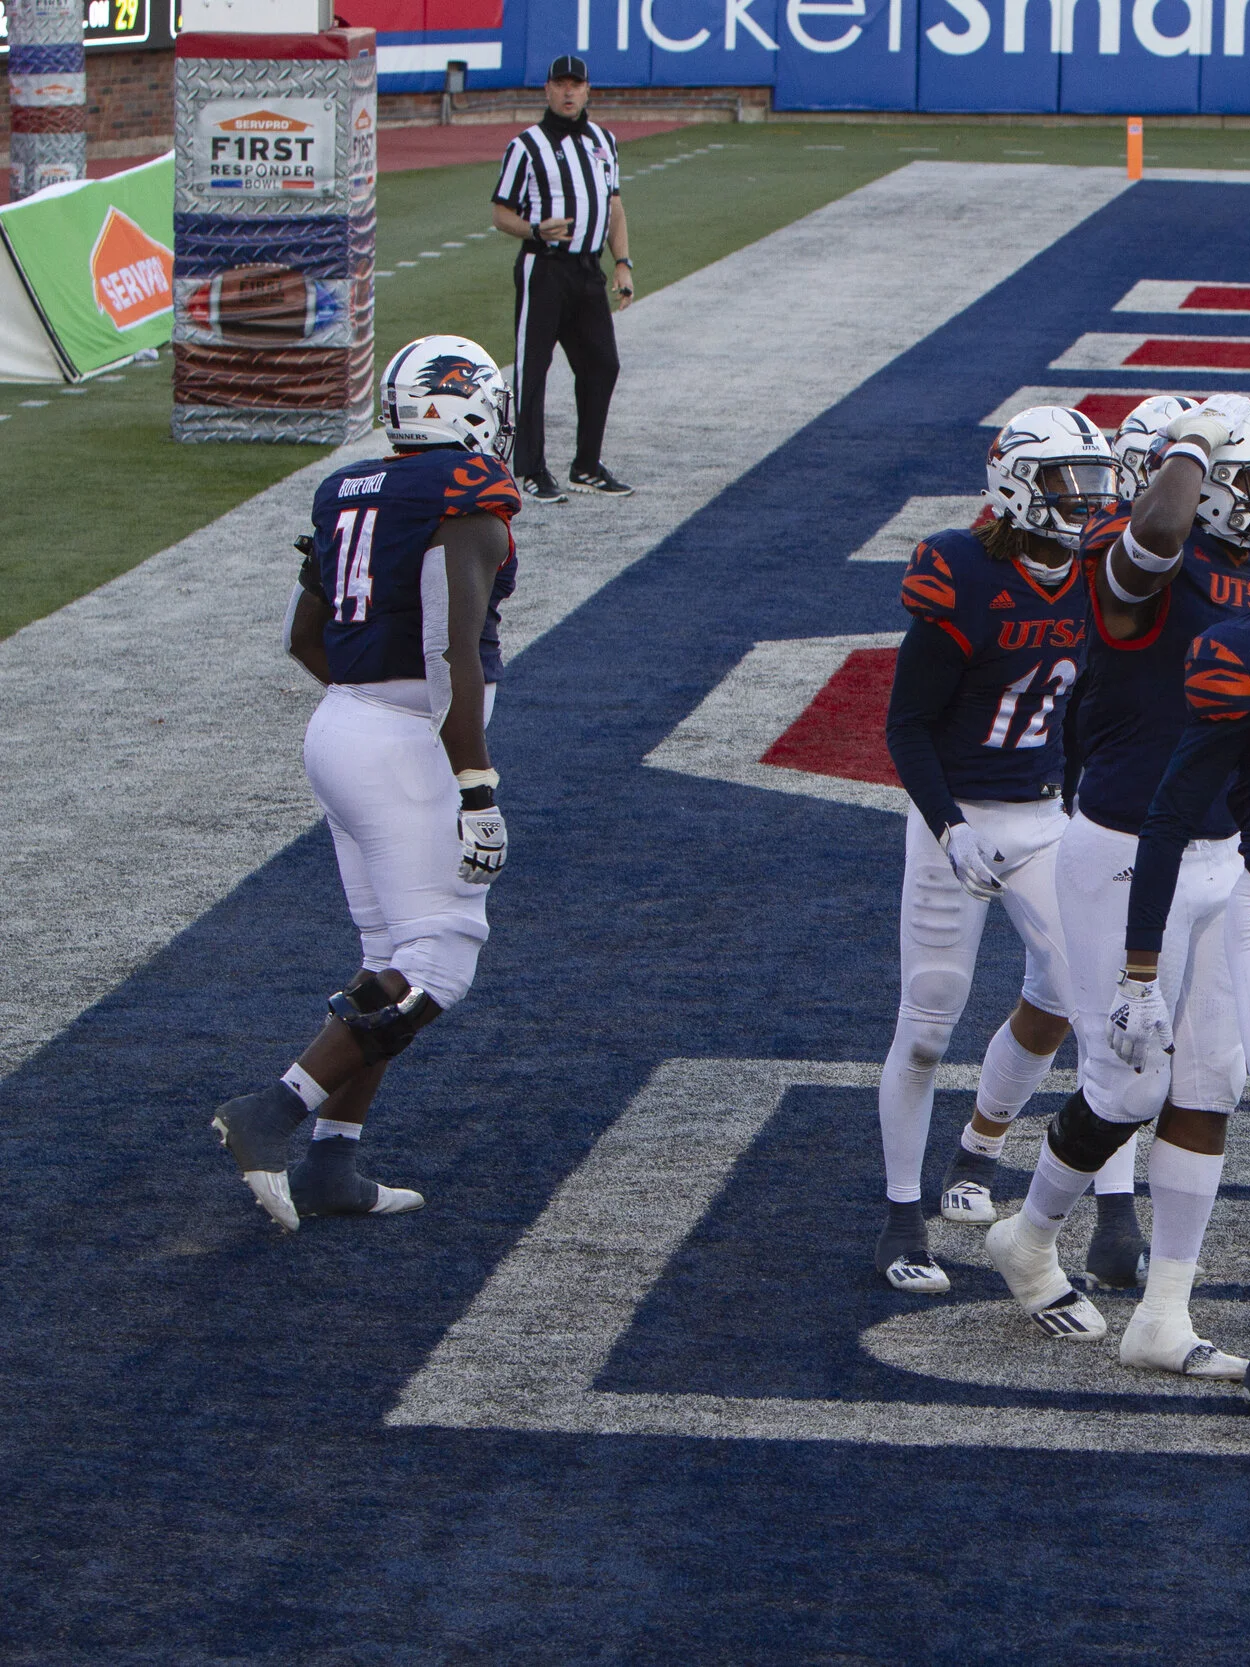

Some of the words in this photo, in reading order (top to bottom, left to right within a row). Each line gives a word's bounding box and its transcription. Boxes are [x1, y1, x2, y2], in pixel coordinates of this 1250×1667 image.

[115, 0, 139, 31] 29
[235, 119, 289, 129] SERVPRO
[211, 136, 315, 161] F1RST
[211, 163, 315, 178] RESPONDER
[244, 179, 279, 189] BOWL
[981, 658, 1078, 749] 12
